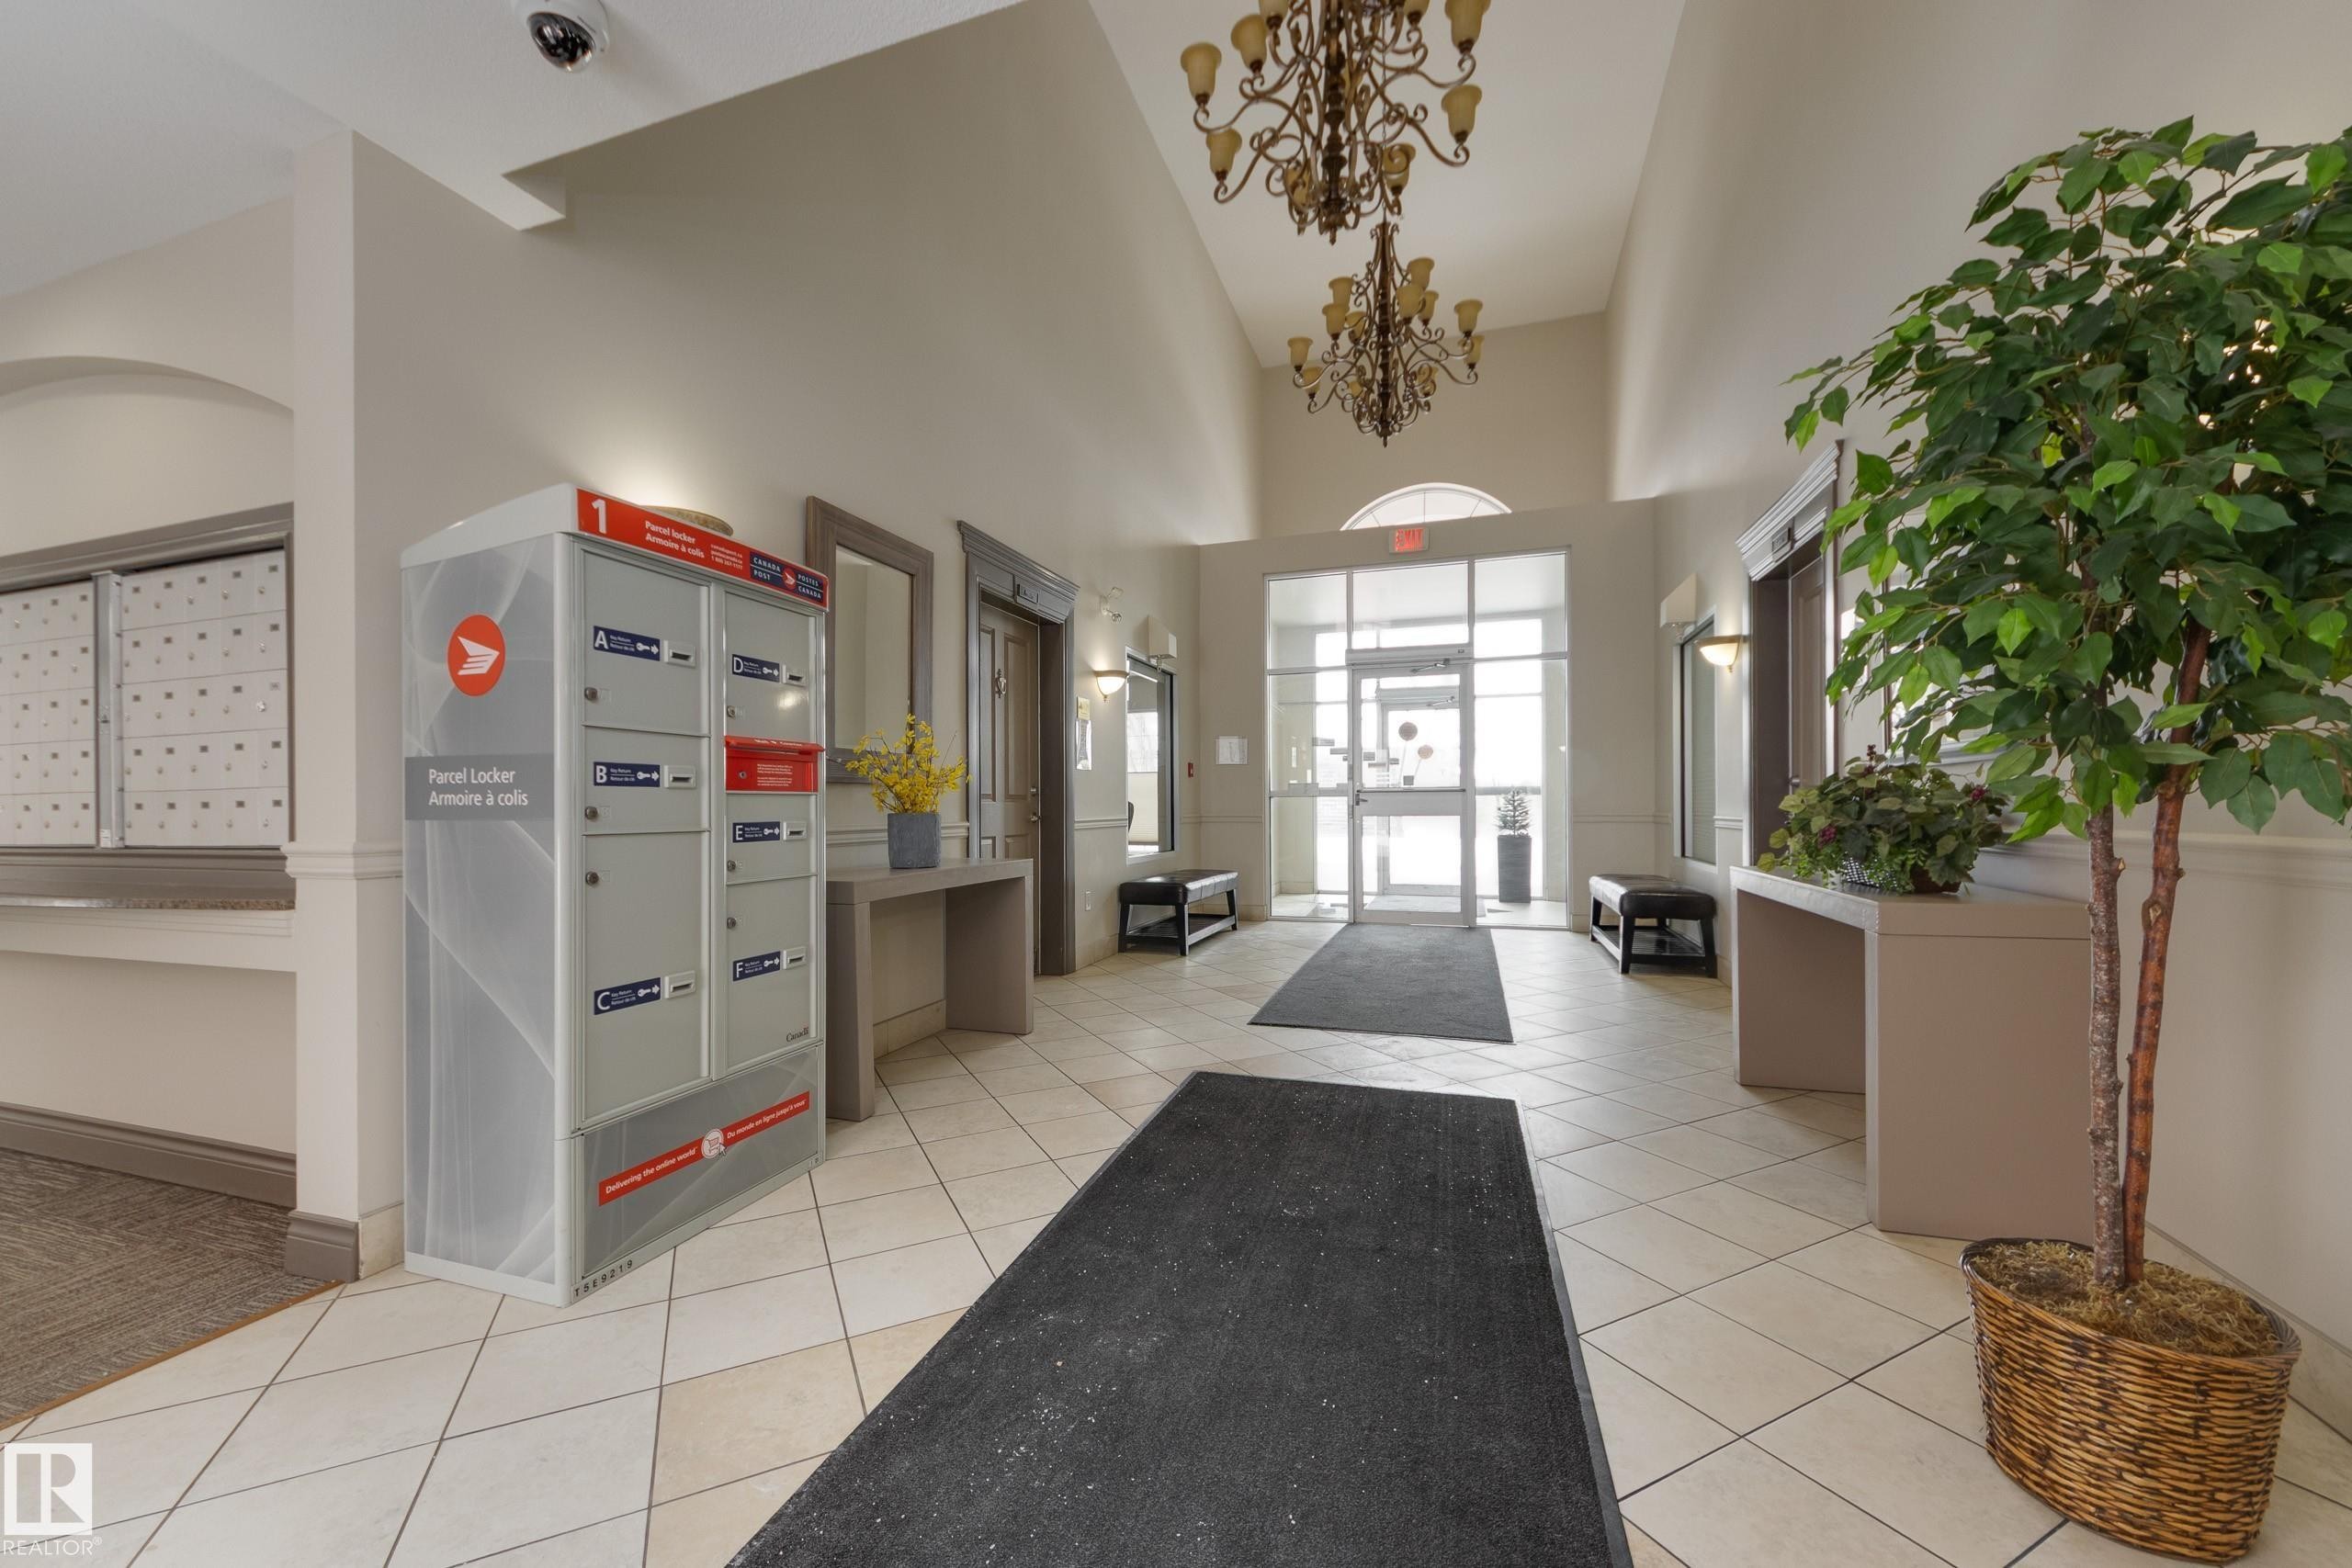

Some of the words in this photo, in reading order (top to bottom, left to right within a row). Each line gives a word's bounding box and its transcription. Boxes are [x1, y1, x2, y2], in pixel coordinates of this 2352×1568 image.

[592, 499, 607, 534] 1
[645, 520, 670, 536] Parcel
[672, 528, 695, 544] locker
[645, 533, 680, 551] Armoire
[680, 543, 686, 553] à
[687, 547, 705, 558] colis
[753, 557, 781, 572] CANADA
[753, 570, 770, 581] POST
[797, 573, 819, 587] POSTES
[797, 586, 821, 599] CANADA
[594, 630, 609, 649] A
[733, 657, 743, 673] D
[428, 767, 467, 784] Parcel
[470, 766, 515, 784] Locker
[595, 765, 607, 783] B
[428, 790, 482, 806] Armoire
[485, 790, 494, 806] à
[497, 789, 528, 806] colis
[736, 825, 743, 840] E
[736, 962, 743, 978] F
[597, 991, 610, 1010] C
[727, 1130, 736, 1139] Du
[736, 1122, 754, 1134] monde
[763, 1112, 775, 1123] ligne
[605, 1172, 642, 1194] Delivering
[643, 1167, 655, 1177] the
[655, 1157, 676, 1171] online
